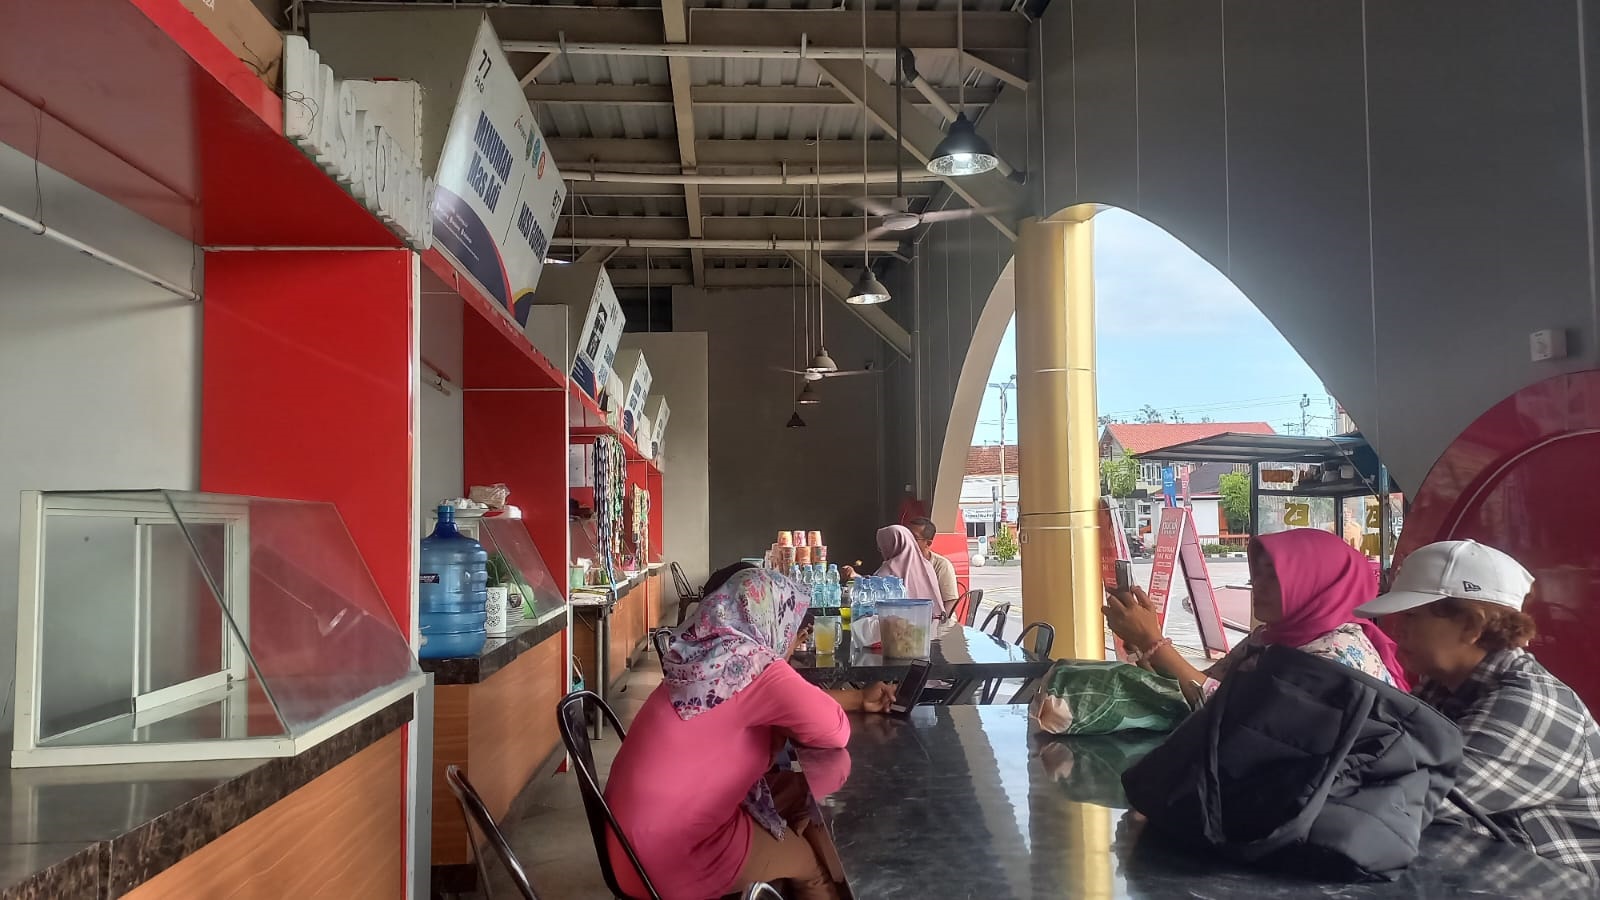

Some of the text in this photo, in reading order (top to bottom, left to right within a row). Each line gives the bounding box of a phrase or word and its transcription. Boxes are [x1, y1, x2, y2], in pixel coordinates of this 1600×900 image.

[478, 48, 492, 80] 77
[473, 109, 514, 186] MINUMAN
[466, 150, 502, 214] Mas Adi
[516, 200, 535, 241] NASI
